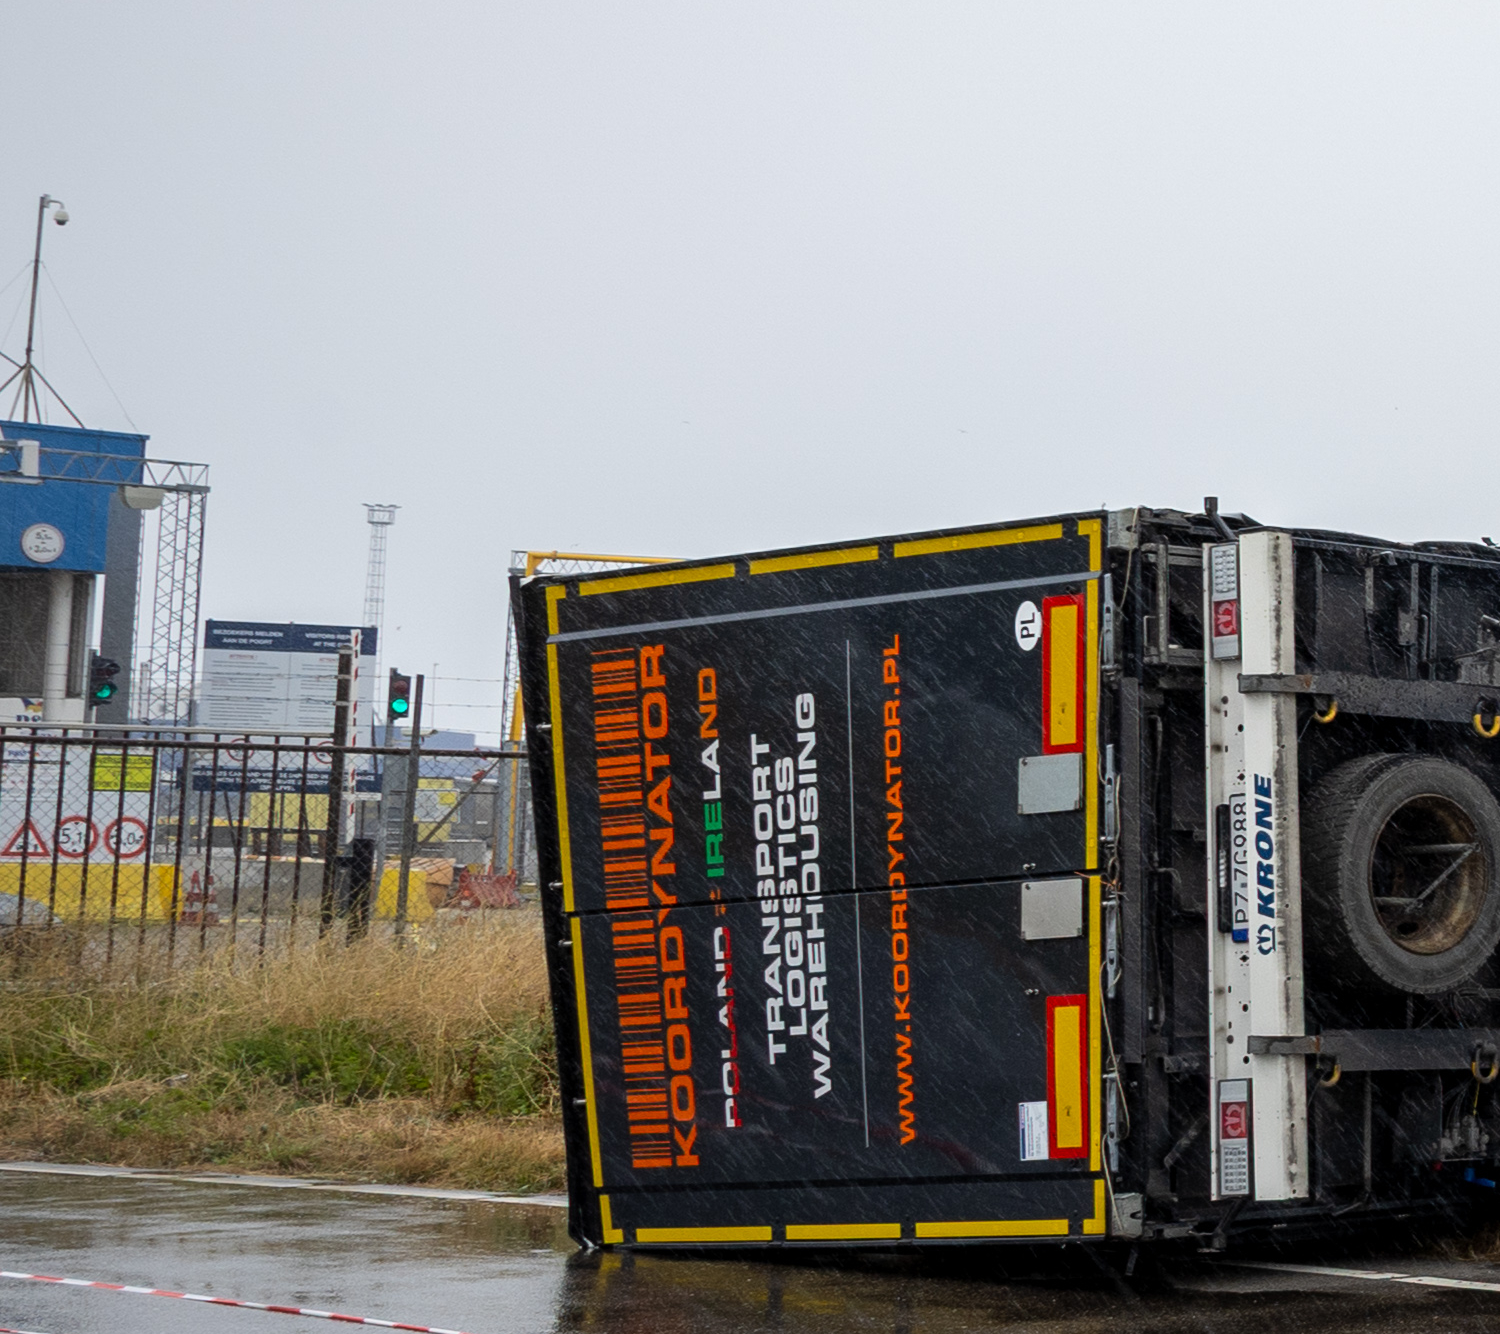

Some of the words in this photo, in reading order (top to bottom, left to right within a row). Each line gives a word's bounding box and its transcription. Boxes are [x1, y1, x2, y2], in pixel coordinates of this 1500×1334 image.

[1020, 612, 1035, 639] PL
[640, 644, 699, 1166] KOORDYNATOR
[698, 667, 725, 877] IRELAND
[750, 734, 786, 1065] TRANSPORT
[775, 757, 807, 1036] LOGISTICS
[795, 693, 833, 1098] WAREHOUSING
[883, 634, 916, 1145] WWW.KOORDYNATOR.PL
[1254, 773, 1275, 919] KRONE
[713, 926, 741, 1128] POLAND
